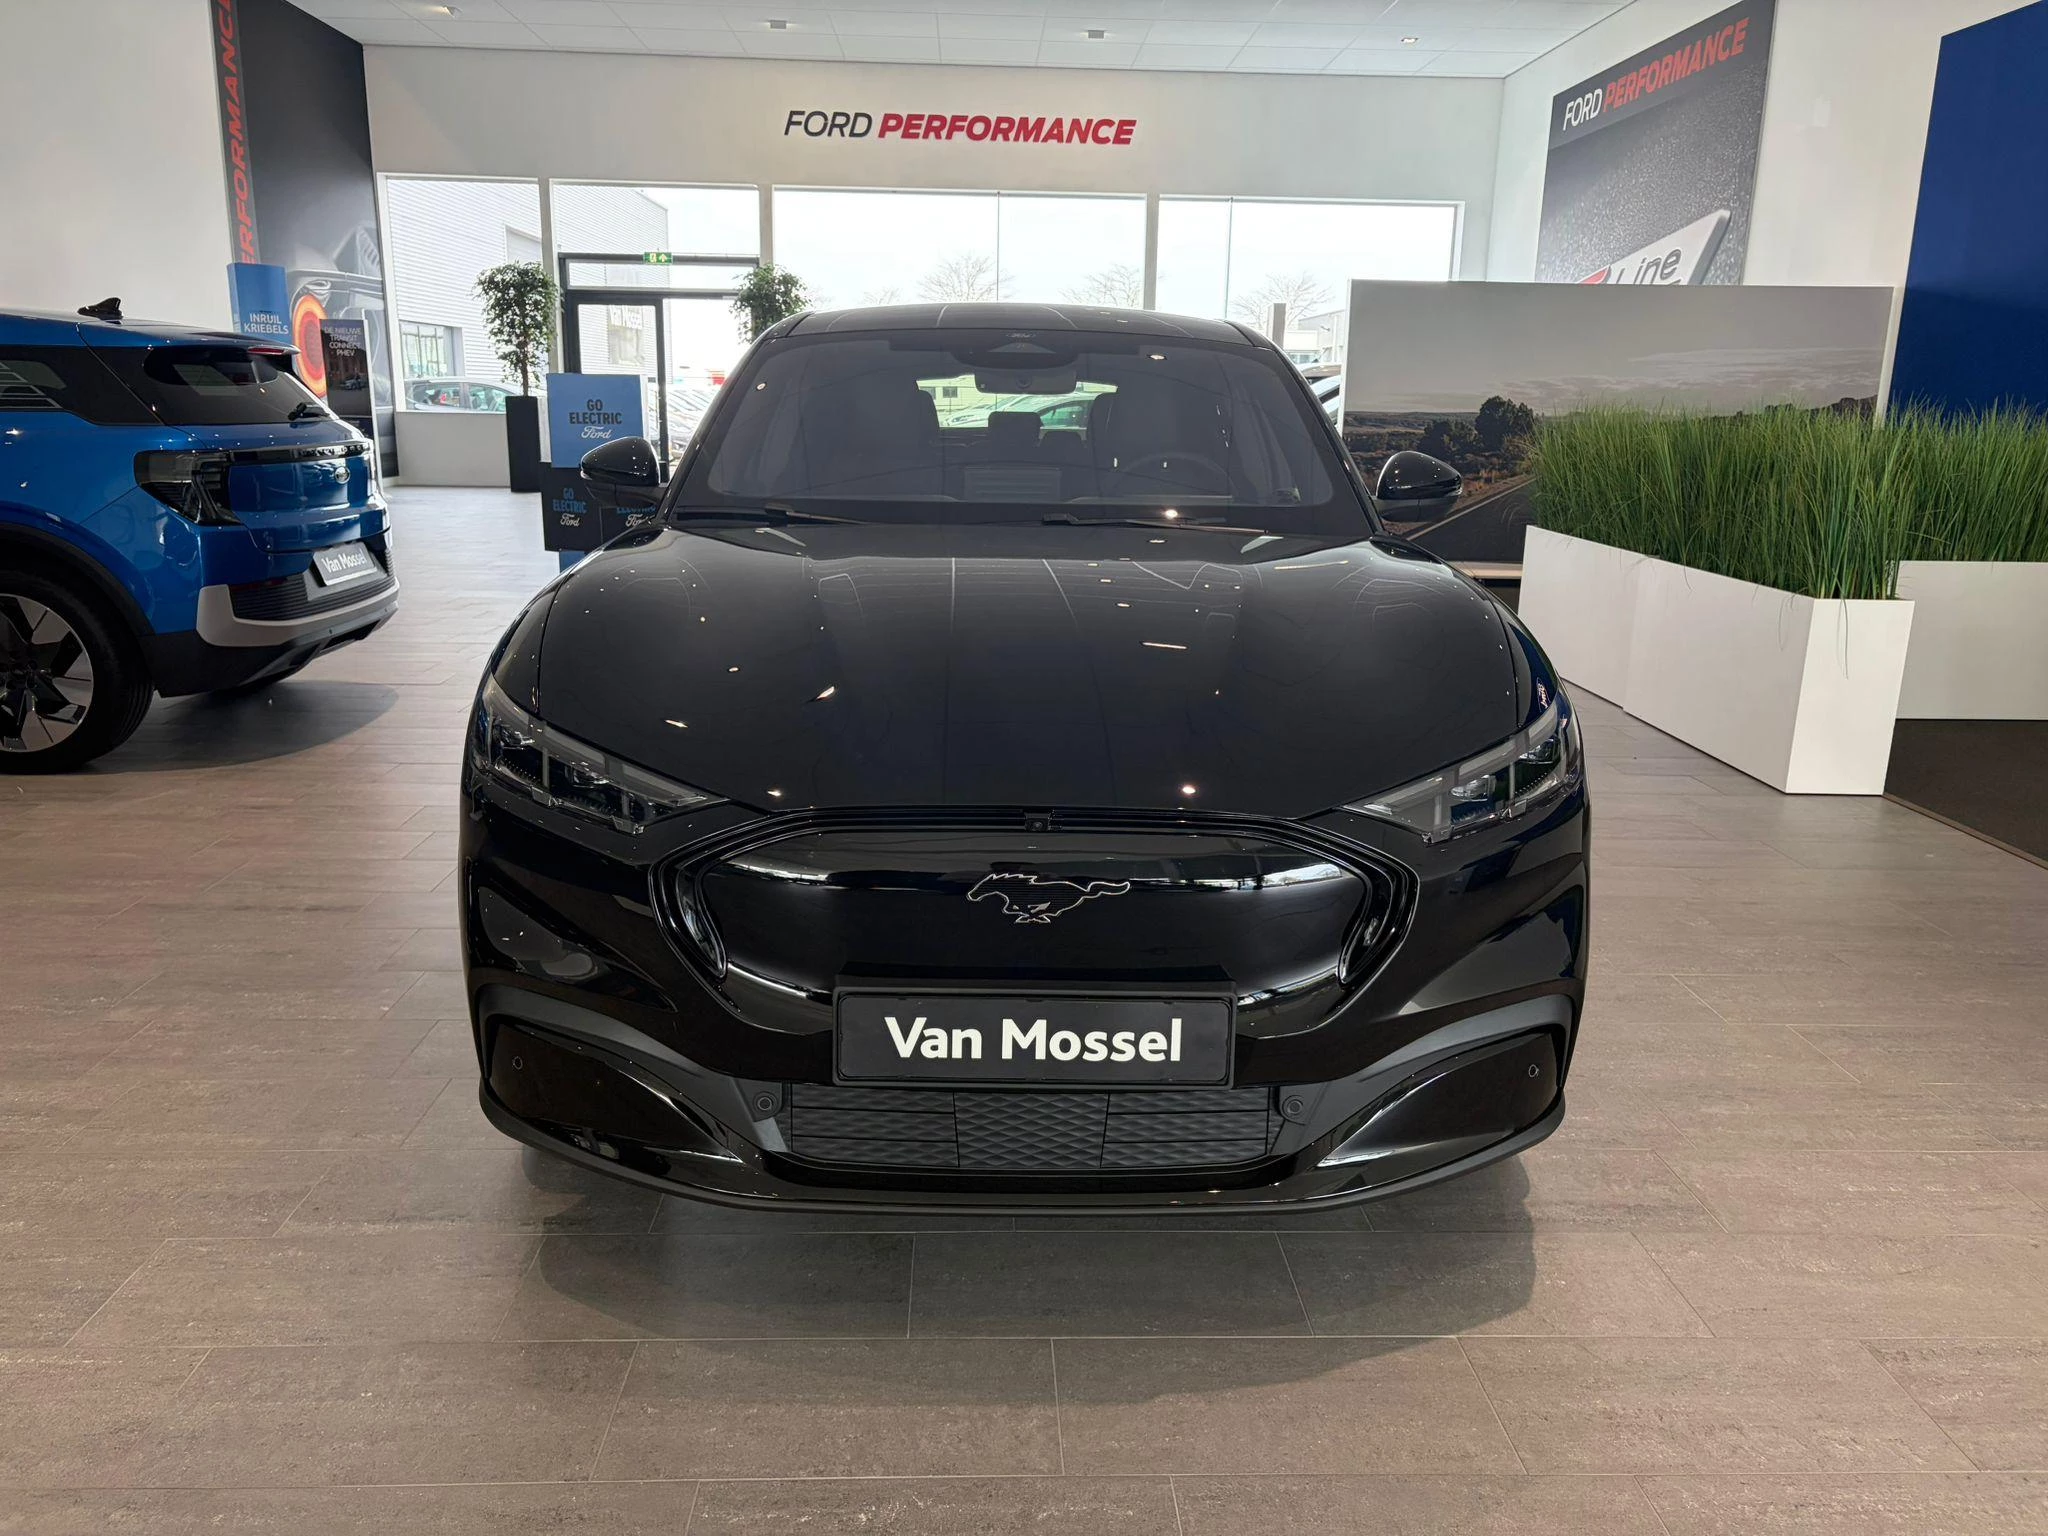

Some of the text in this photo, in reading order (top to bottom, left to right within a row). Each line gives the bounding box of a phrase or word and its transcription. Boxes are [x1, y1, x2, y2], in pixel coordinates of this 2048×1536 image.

[1562, 17, 1750, 131] FORD PERFORMANCE
[784, 110, 1137, 145] FORD PERFORMANCE
[249, 312, 282, 325] INRUIL
[243, 322, 289, 335] KRIEBELS
[587, 399, 603, 411] GO
[569, 412, 622, 425] ELECTRIC
[581, 426, 612, 439] Ford
[563, 488, 575, 500] GO
[553, 500, 587, 514] ELECTRIC
[560, 513, 581, 527] Ford
[321, 548, 368, 573] Van Mossel
[884, 1016, 1183, 1063] Van Mossel
